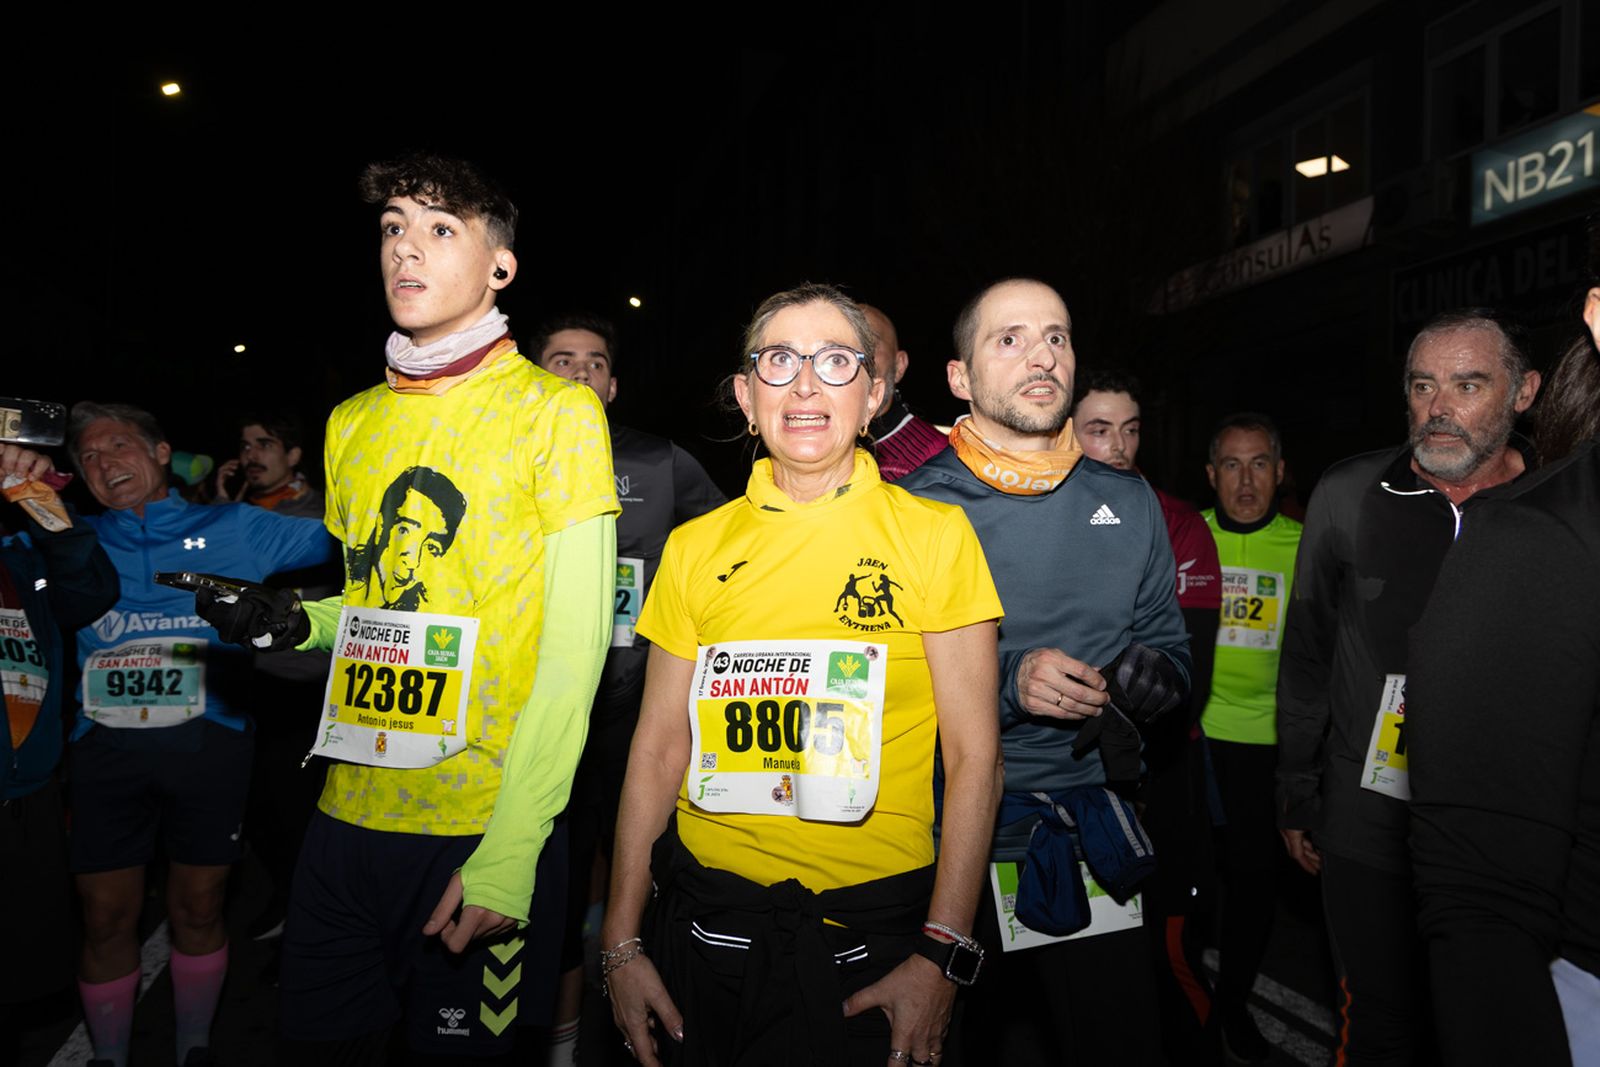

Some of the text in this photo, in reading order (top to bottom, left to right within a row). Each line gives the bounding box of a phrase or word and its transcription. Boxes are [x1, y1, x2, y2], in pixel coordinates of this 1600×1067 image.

[1483, 130, 1594, 211] NB21
[1512, 234, 1576, 297] DEL
[1089, 517, 1121, 525] adidas
[857, 557, 888, 571] JAEN
[615, 589, 631, 615] 2
[838, 614, 892, 632] ENTRENA
[359, 625, 391, 642] NOCHE
[393, 629, 411, 644] DE
[344, 641, 410, 664] SAN ANTÓN
[714, 656, 728, 669] 43
[97, 658, 120, 669] SAN
[731, 657, 812, 674] NOCHE DE
[107, 669, 183, 697] 9342
[345, 664, 447, 716] 12387
[710, 673, 809, 698] SAN ANTÓN
[357, 713, 415, 730] Antonio jesus
[724, 700, 845, 756] 8805
